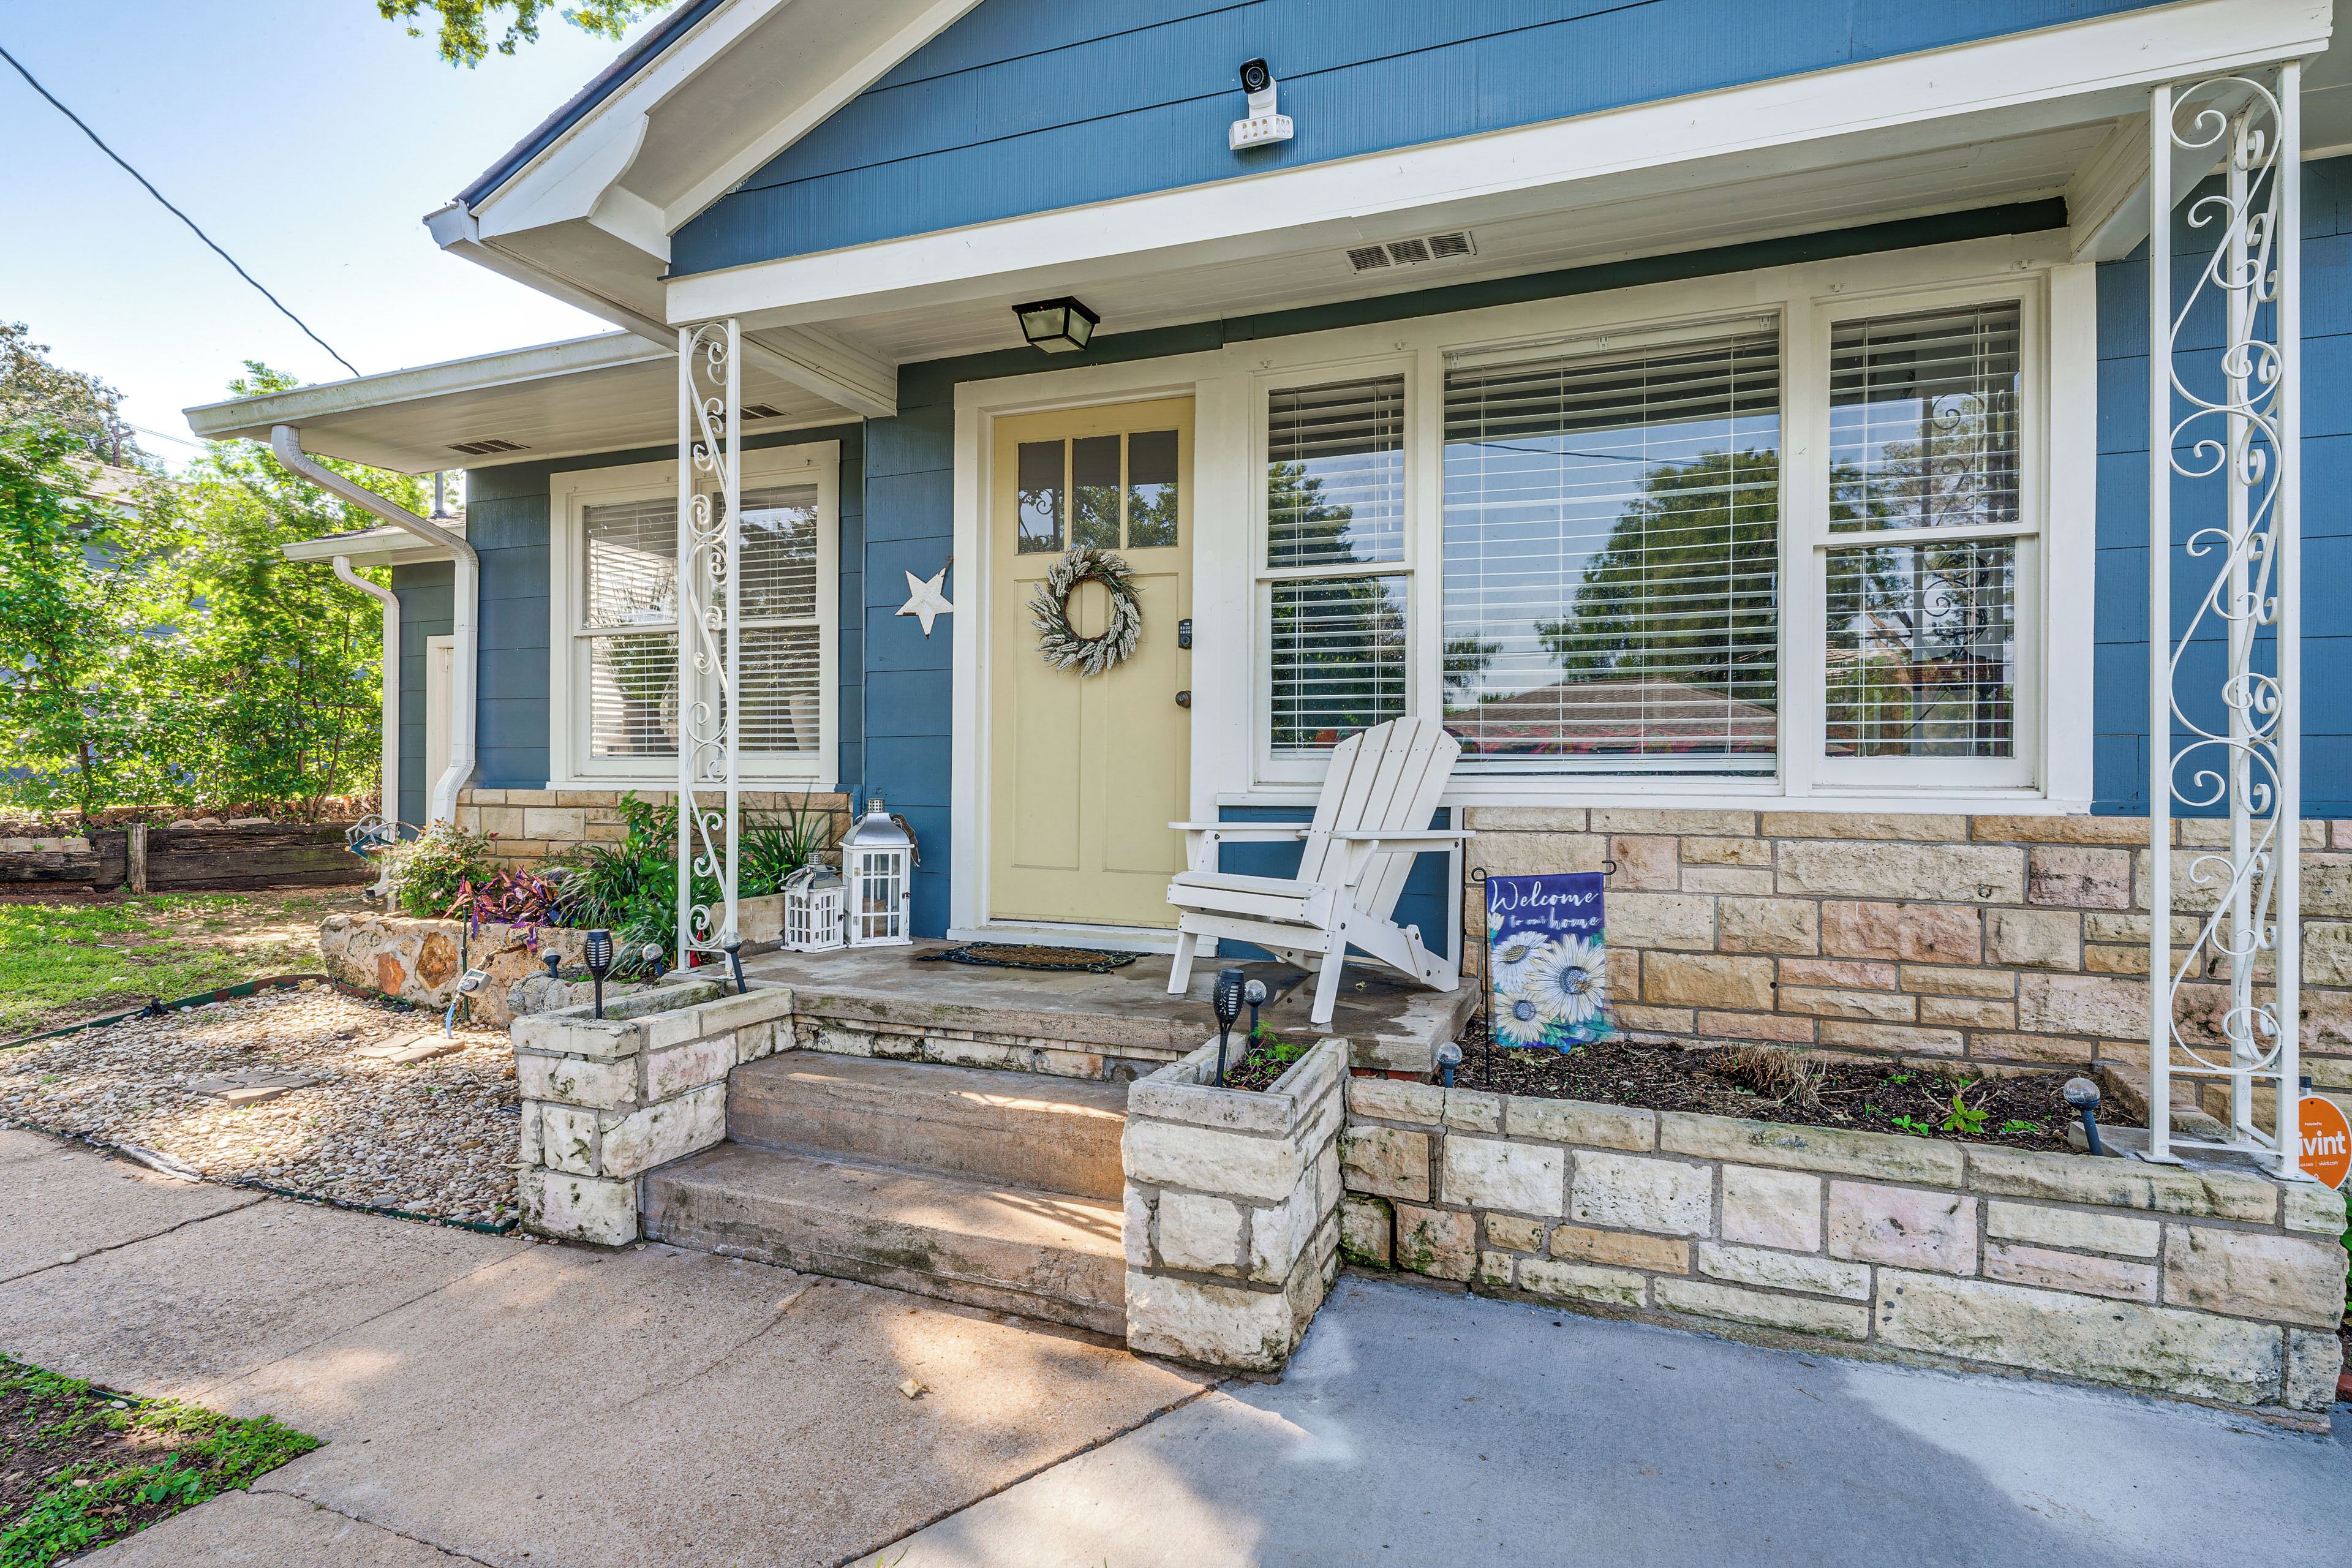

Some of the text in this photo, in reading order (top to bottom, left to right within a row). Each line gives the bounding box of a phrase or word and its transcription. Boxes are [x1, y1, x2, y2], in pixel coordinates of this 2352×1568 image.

[1490, 879, 1599, 913] Welcome
[1509, 907, 1603, 930] to our home
[2299, 1130, 2346, 1157] ivint
